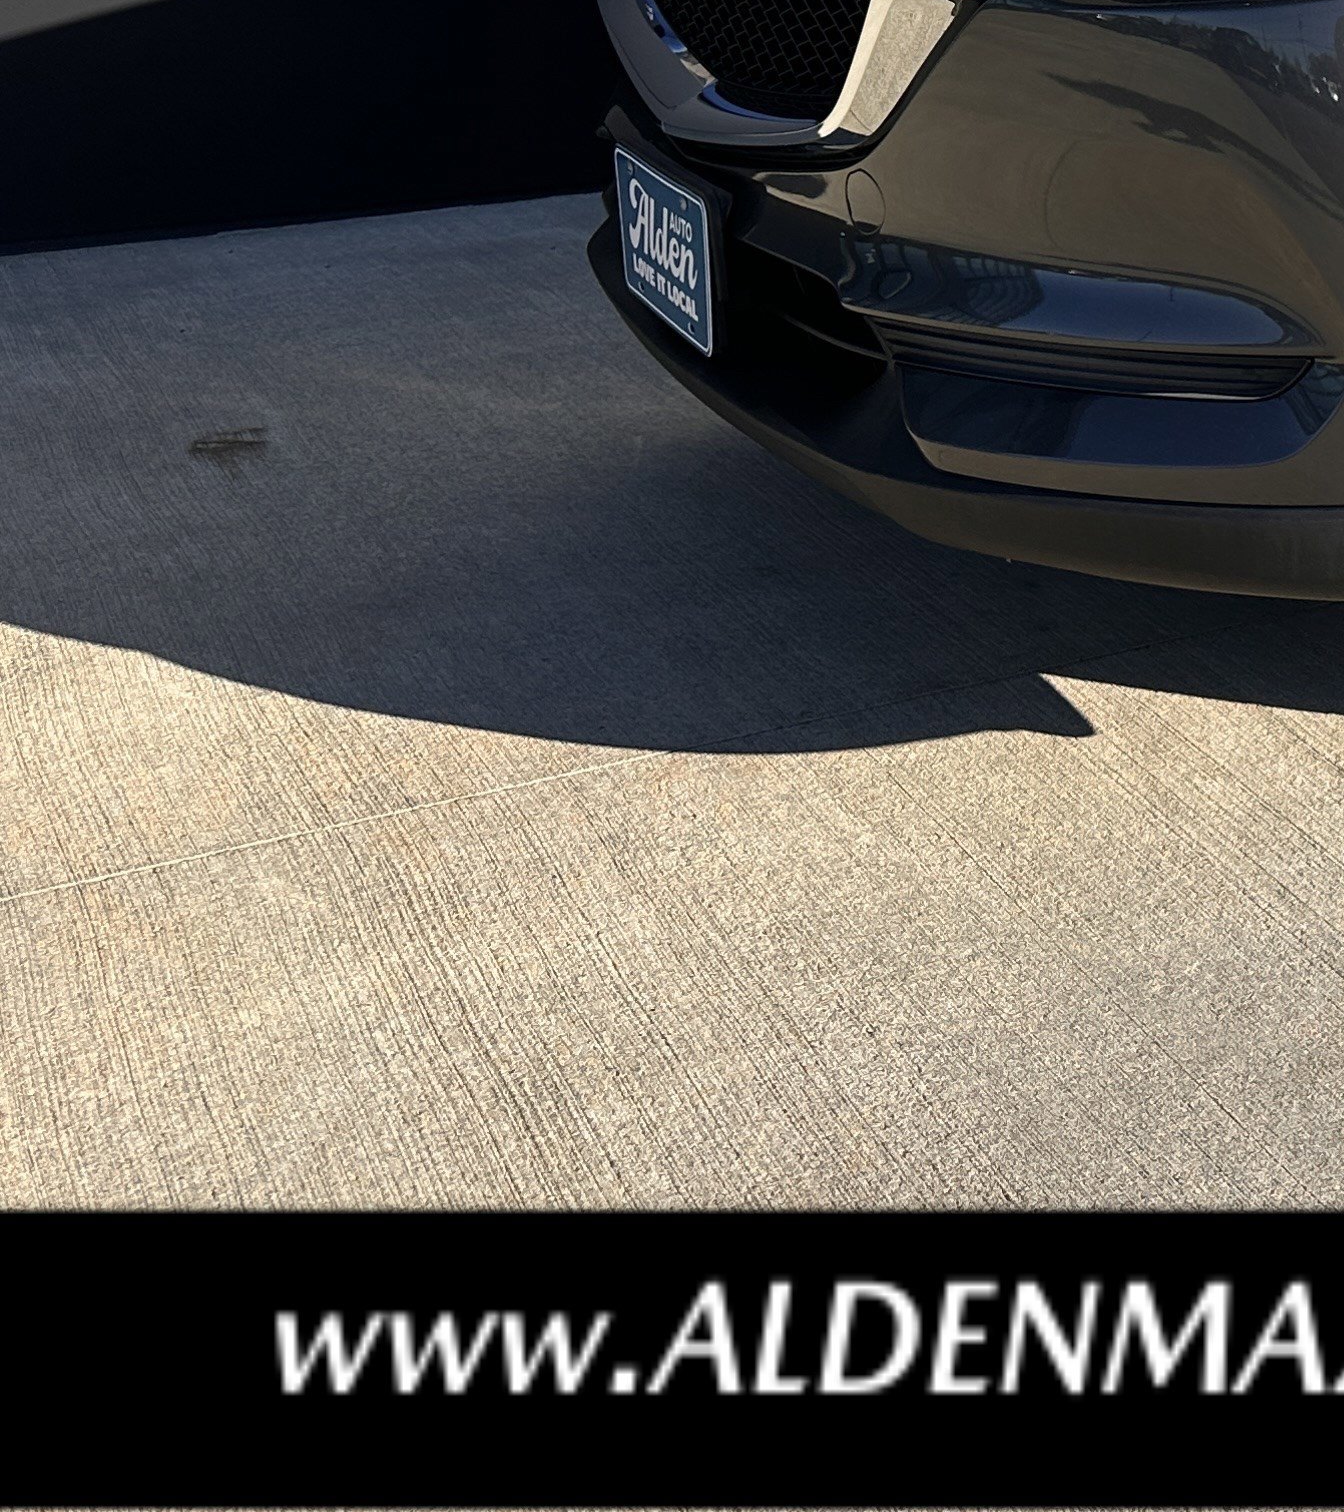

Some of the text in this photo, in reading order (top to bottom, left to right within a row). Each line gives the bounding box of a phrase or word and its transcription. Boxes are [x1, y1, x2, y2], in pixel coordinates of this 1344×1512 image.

[629, 178, 698, 290] Alden
[669, 211, 693, 243] AUTO
[632, 252, 699, 322] LOVE IT LOCAL
